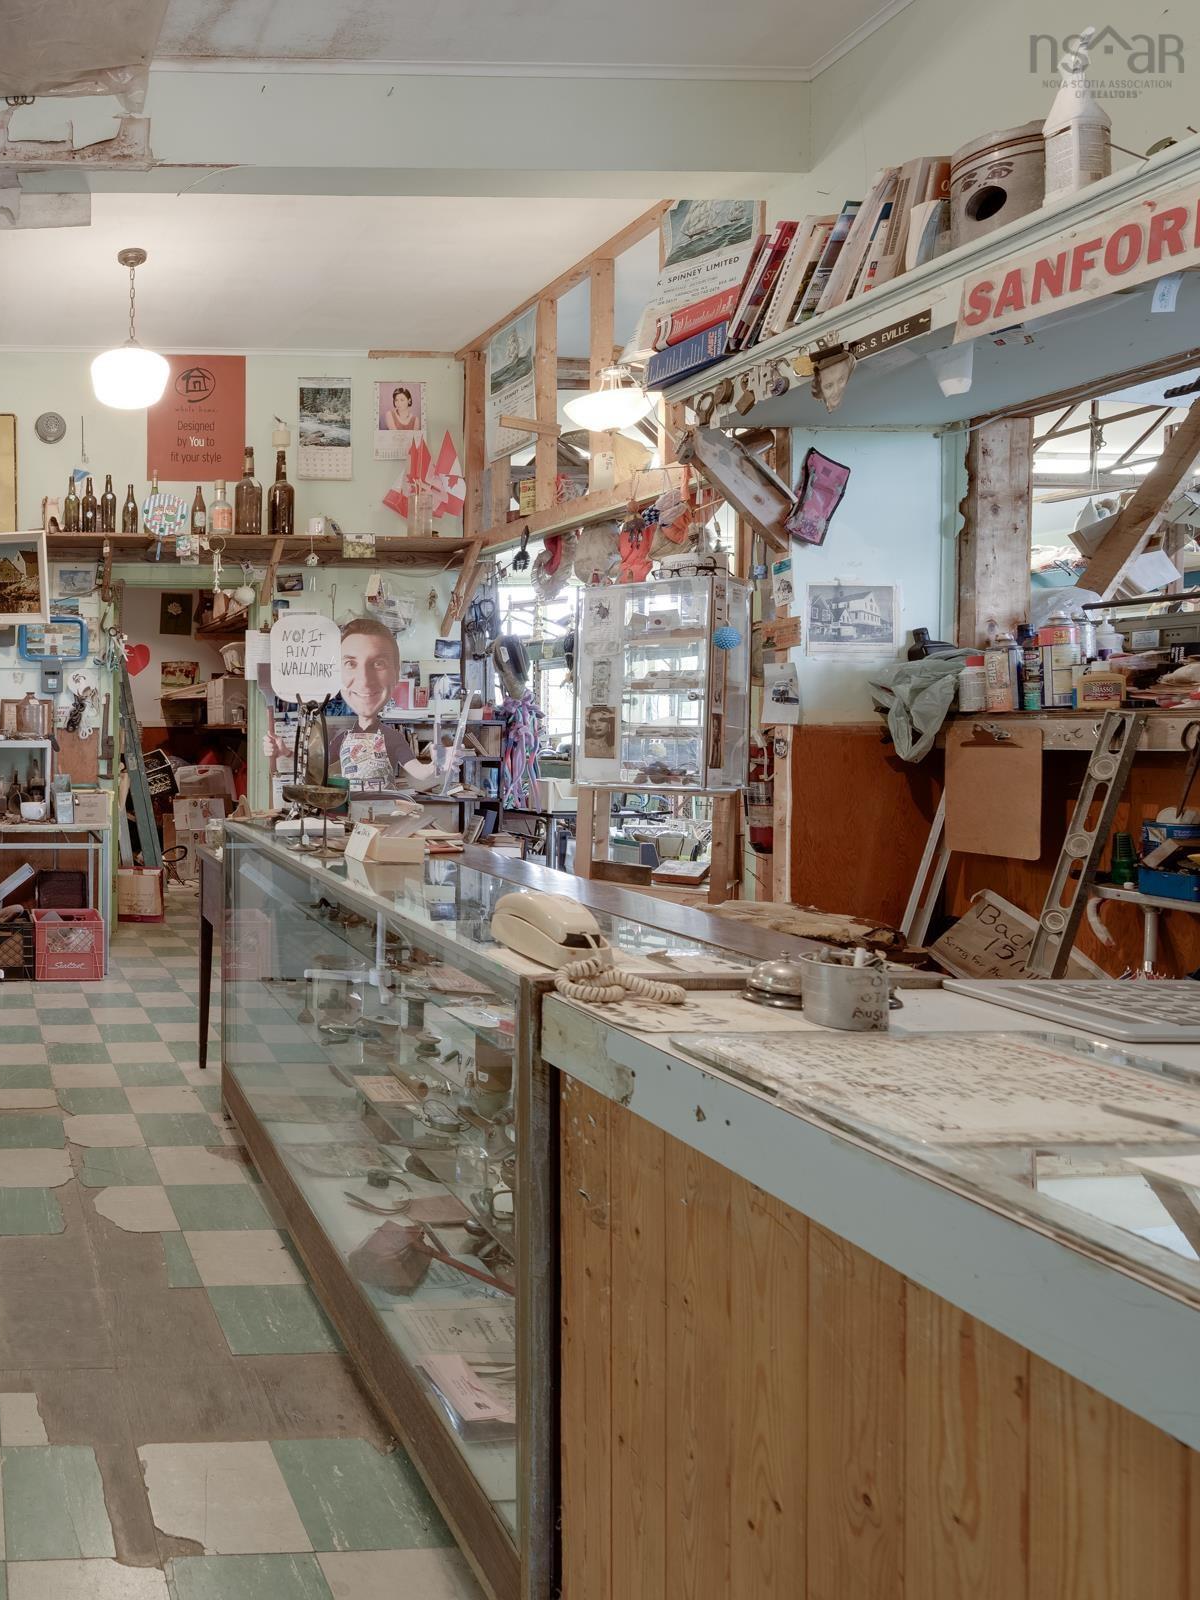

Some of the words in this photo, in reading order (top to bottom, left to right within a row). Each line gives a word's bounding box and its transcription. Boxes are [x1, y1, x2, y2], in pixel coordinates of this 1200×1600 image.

[667, 267, 703, 285] SPINNEY
[705, 256, 741, 272] LIMITED
[870, 337, 878, 348] S.
[881, 323, 910, 343] EVILLE
[177, 420, 215, 433] Designed
[177, 436, 188, 448] by
[189, 435, 205, 447] You
[206, 437, 215, 447] to
[170, 451, 179, 463] fit
[181, 454, 200, 465] your
[201, 451, 222, 465] style
[281, 628, 306, 644] NO!
[286, 645, 322, 658] AINT
[984, 938, 1015, 960] 15
